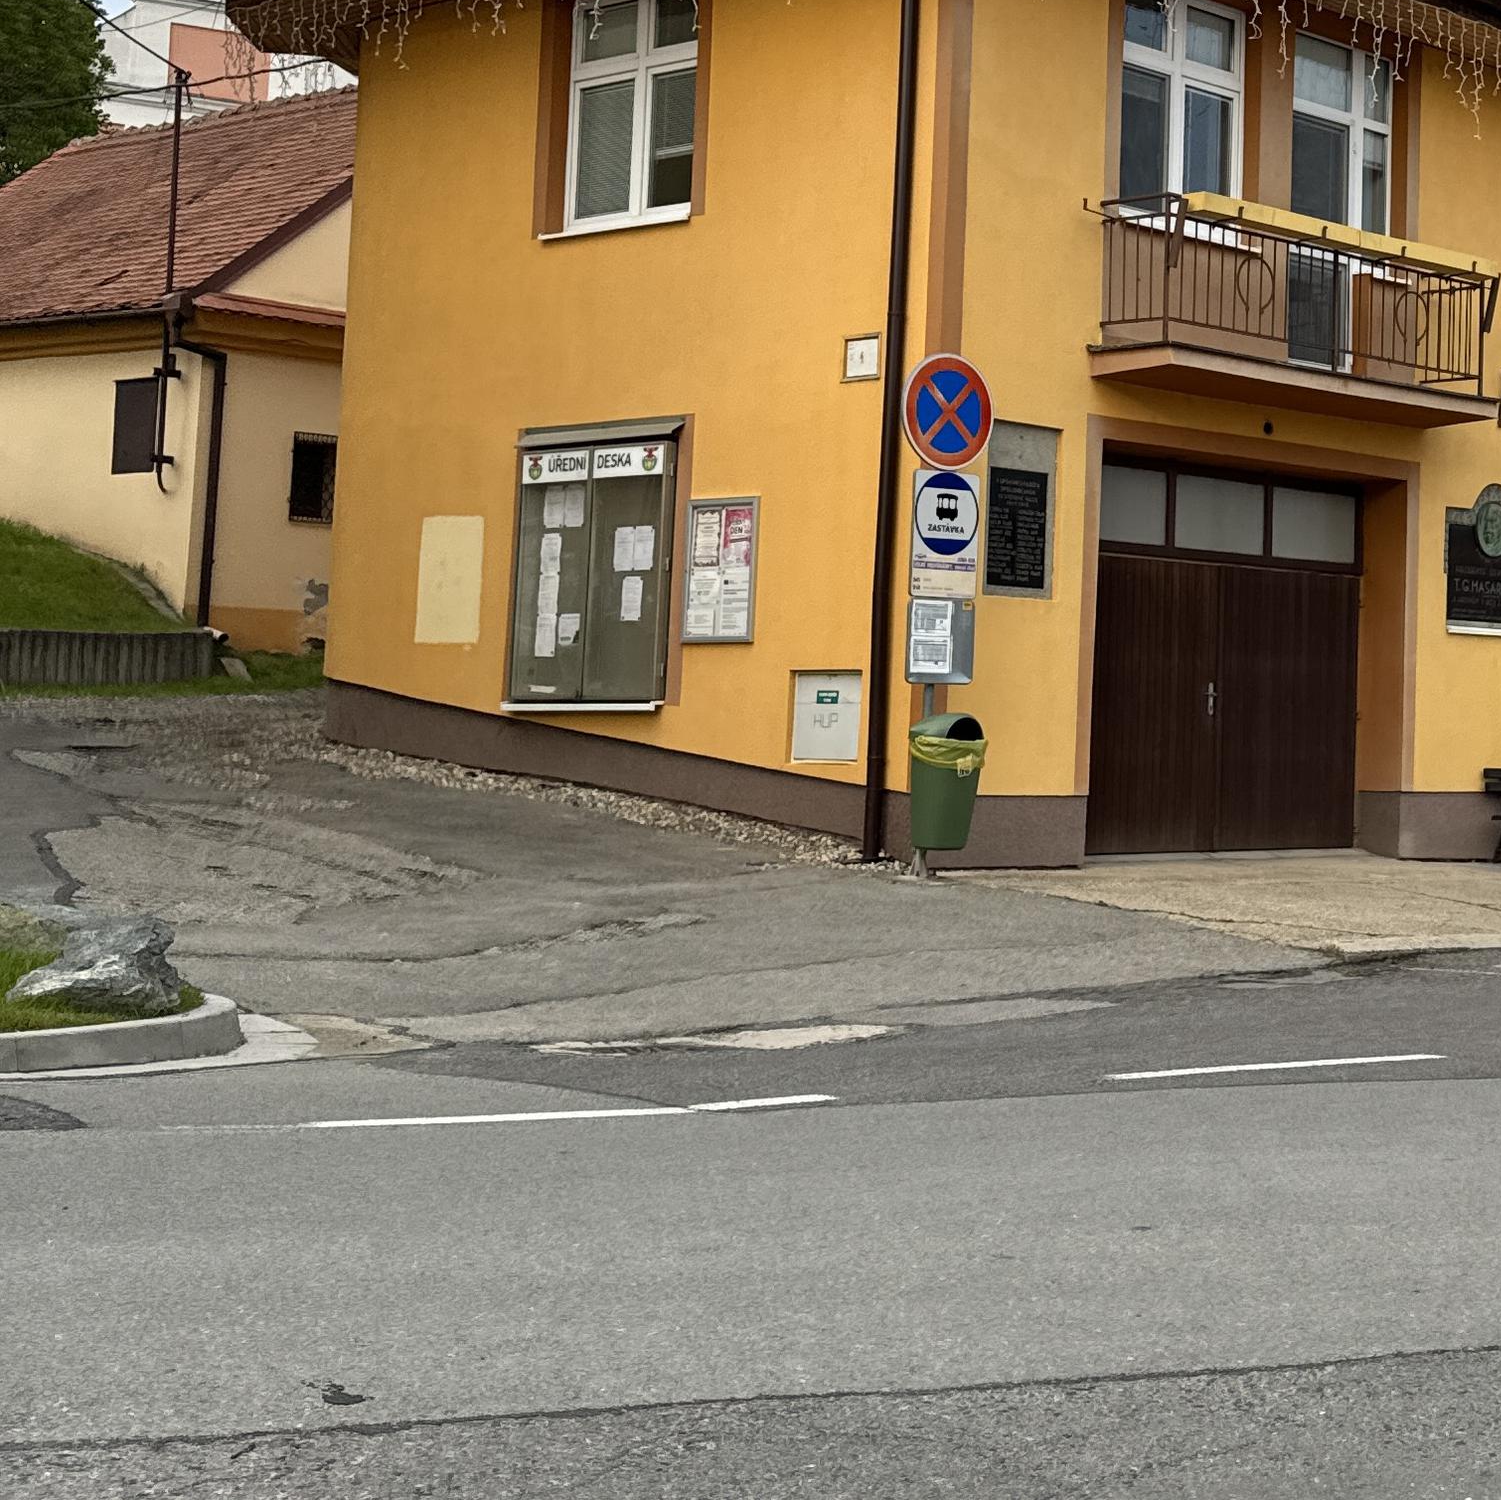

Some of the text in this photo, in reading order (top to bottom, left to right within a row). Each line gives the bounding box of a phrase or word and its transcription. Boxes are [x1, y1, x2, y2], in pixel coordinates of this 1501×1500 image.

[548, 452, 632, 473] ÚŘEDNÍ DESKA
[927, 523, 965, 534] ZASTÁVKA
[813, 712, 838, 729] HUP
